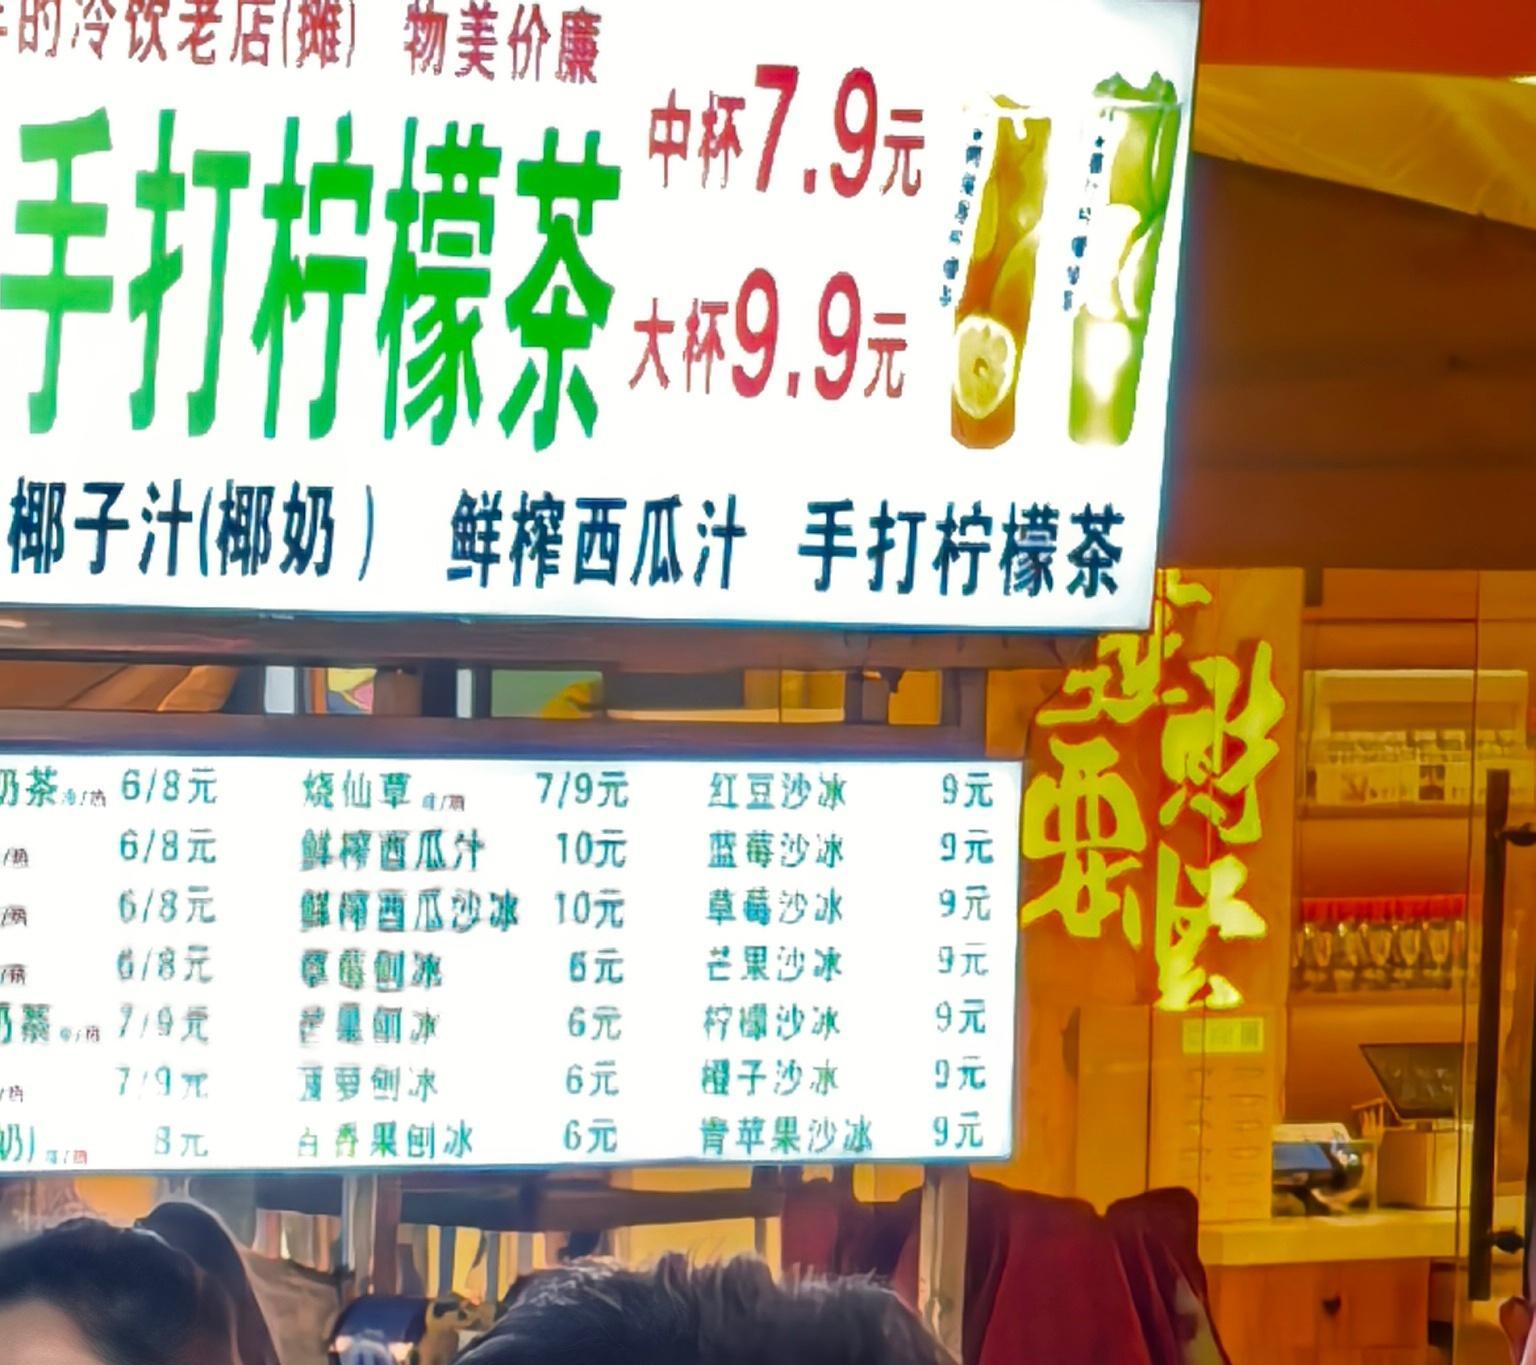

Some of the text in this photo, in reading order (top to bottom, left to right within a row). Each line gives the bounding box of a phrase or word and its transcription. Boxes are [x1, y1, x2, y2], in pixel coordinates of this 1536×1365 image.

[405, 0, 601, 83] 物美价廉
[649, 64, 924, 198] 中杯7.9元
[629, 268, 907, 400] 大杯9.9元
[447, 489, 747, 590] 鲜榨西瓜汁
[798, 498, 1125, 598] 手打柠檬茶
[119, 767, 218, 804] 6/8元
[535, 770, 629, 810] 7/9元
[708, 770, 994, 811] 红豆沙冰 9元
[118, 828, 217, 864] 6/8元
[557, 829, 627, 868] 10元
[708, 829, 995, 869] 蓝莓沙冰 9元
[117, 885, 216, 924] 6/8元
[555, 889, 625, 929] 10元
[706, 884, 991, 927] 草莓沙冰 9元
[115, 944, 213, 984] 6/8元
[569, 948, 624, 984] 6元
[707, 943, 989, 983] 芒果沙冰 9元
[568, 1006, 621, 1040] 6元
[934, 998, 987, 1035] 9元
[566, 1060, 619, 1096] 6元
[701, 1056, 987, 1096] 橙子沙冰 9元
[563, 1119, 617, 1154] 6元
[700, 1110, 984, 1158] 青苹果沙冰 9元
